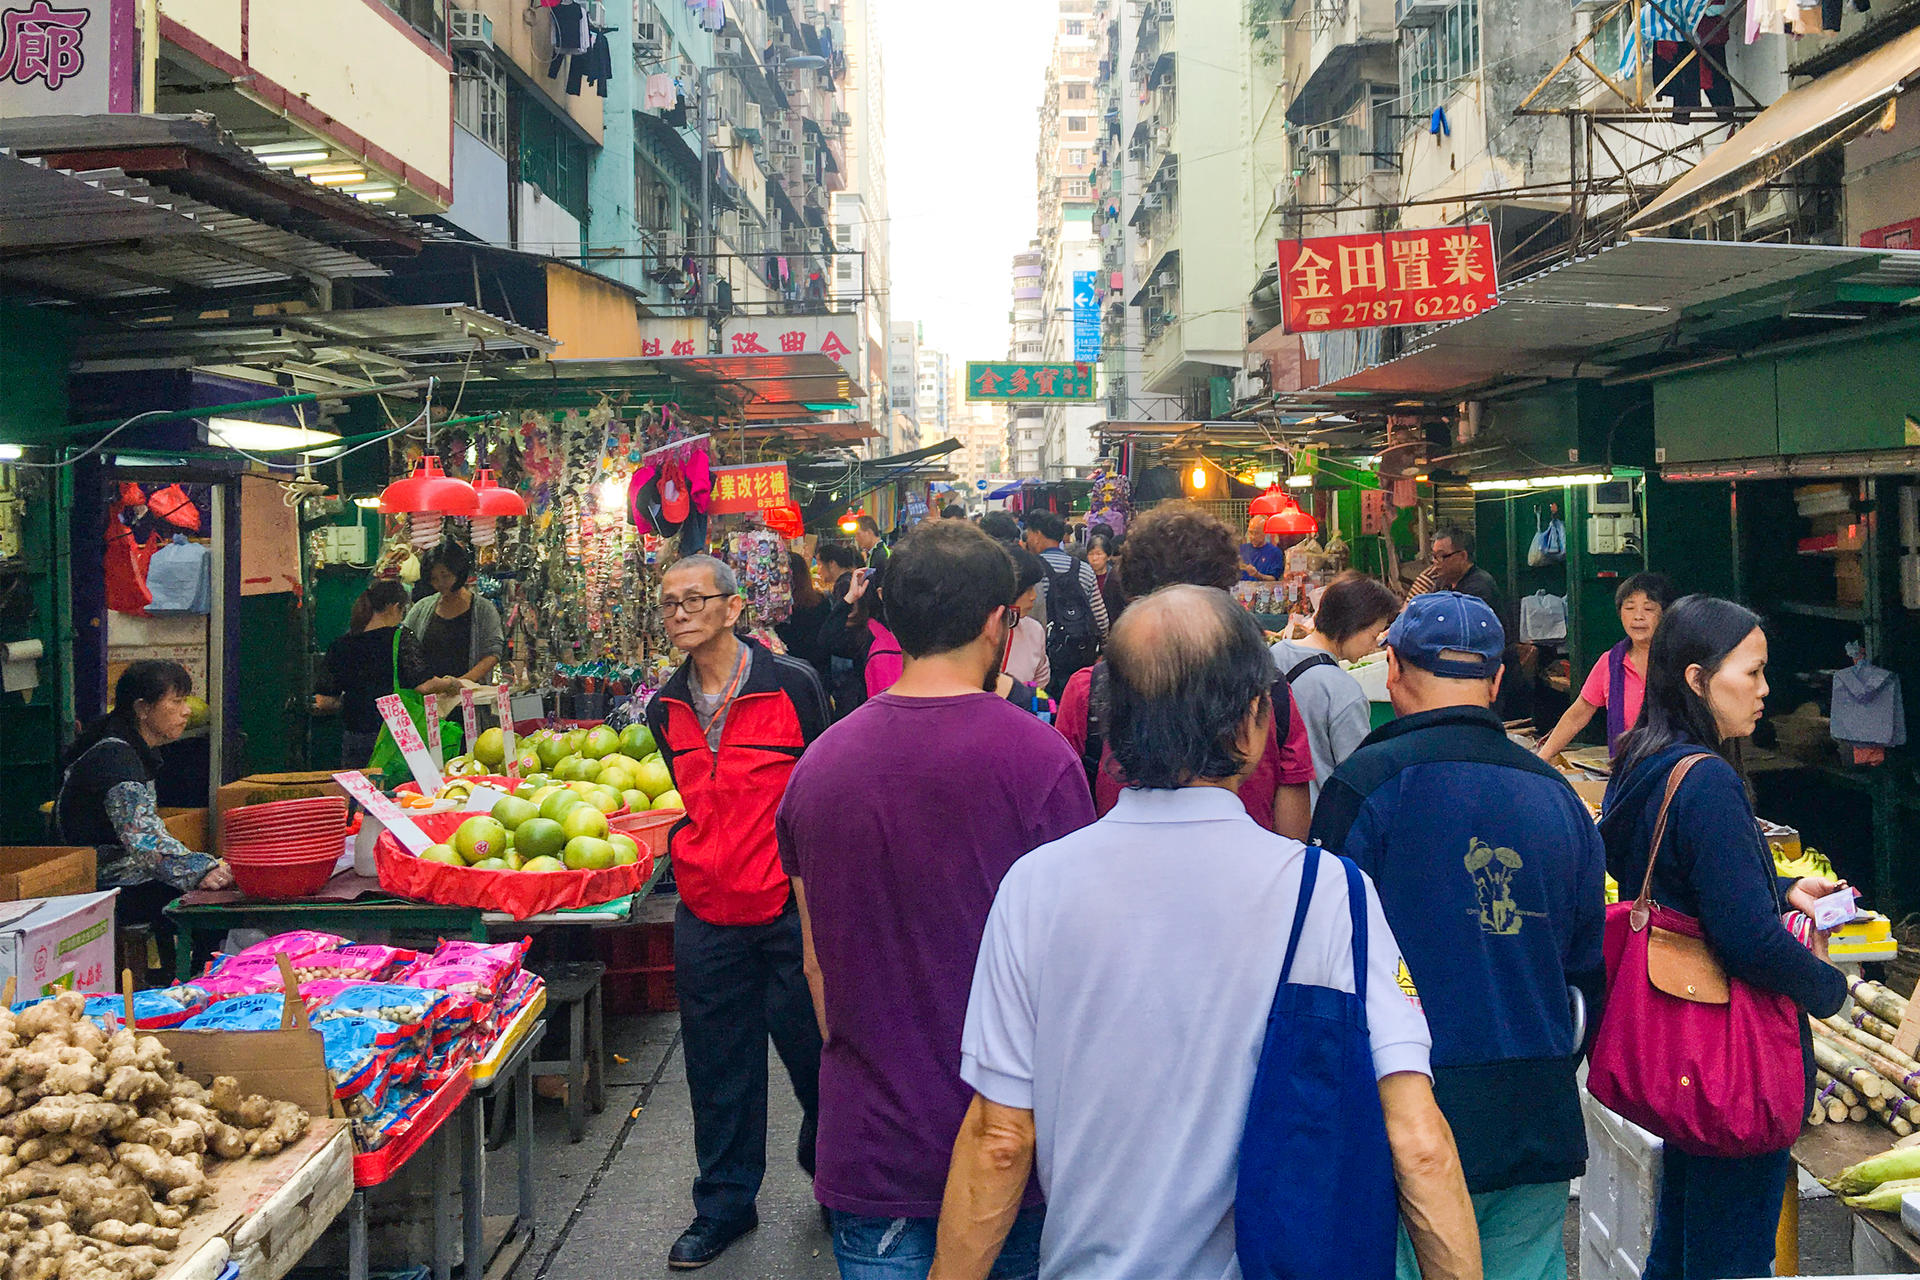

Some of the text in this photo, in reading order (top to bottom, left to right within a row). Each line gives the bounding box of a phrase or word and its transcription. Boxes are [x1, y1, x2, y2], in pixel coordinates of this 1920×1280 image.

[0, 0, 91, 91] 廊
[1289, 234, 1486, 300] 金田置業
[1341, 293, 1477, 323] 2787 6226
